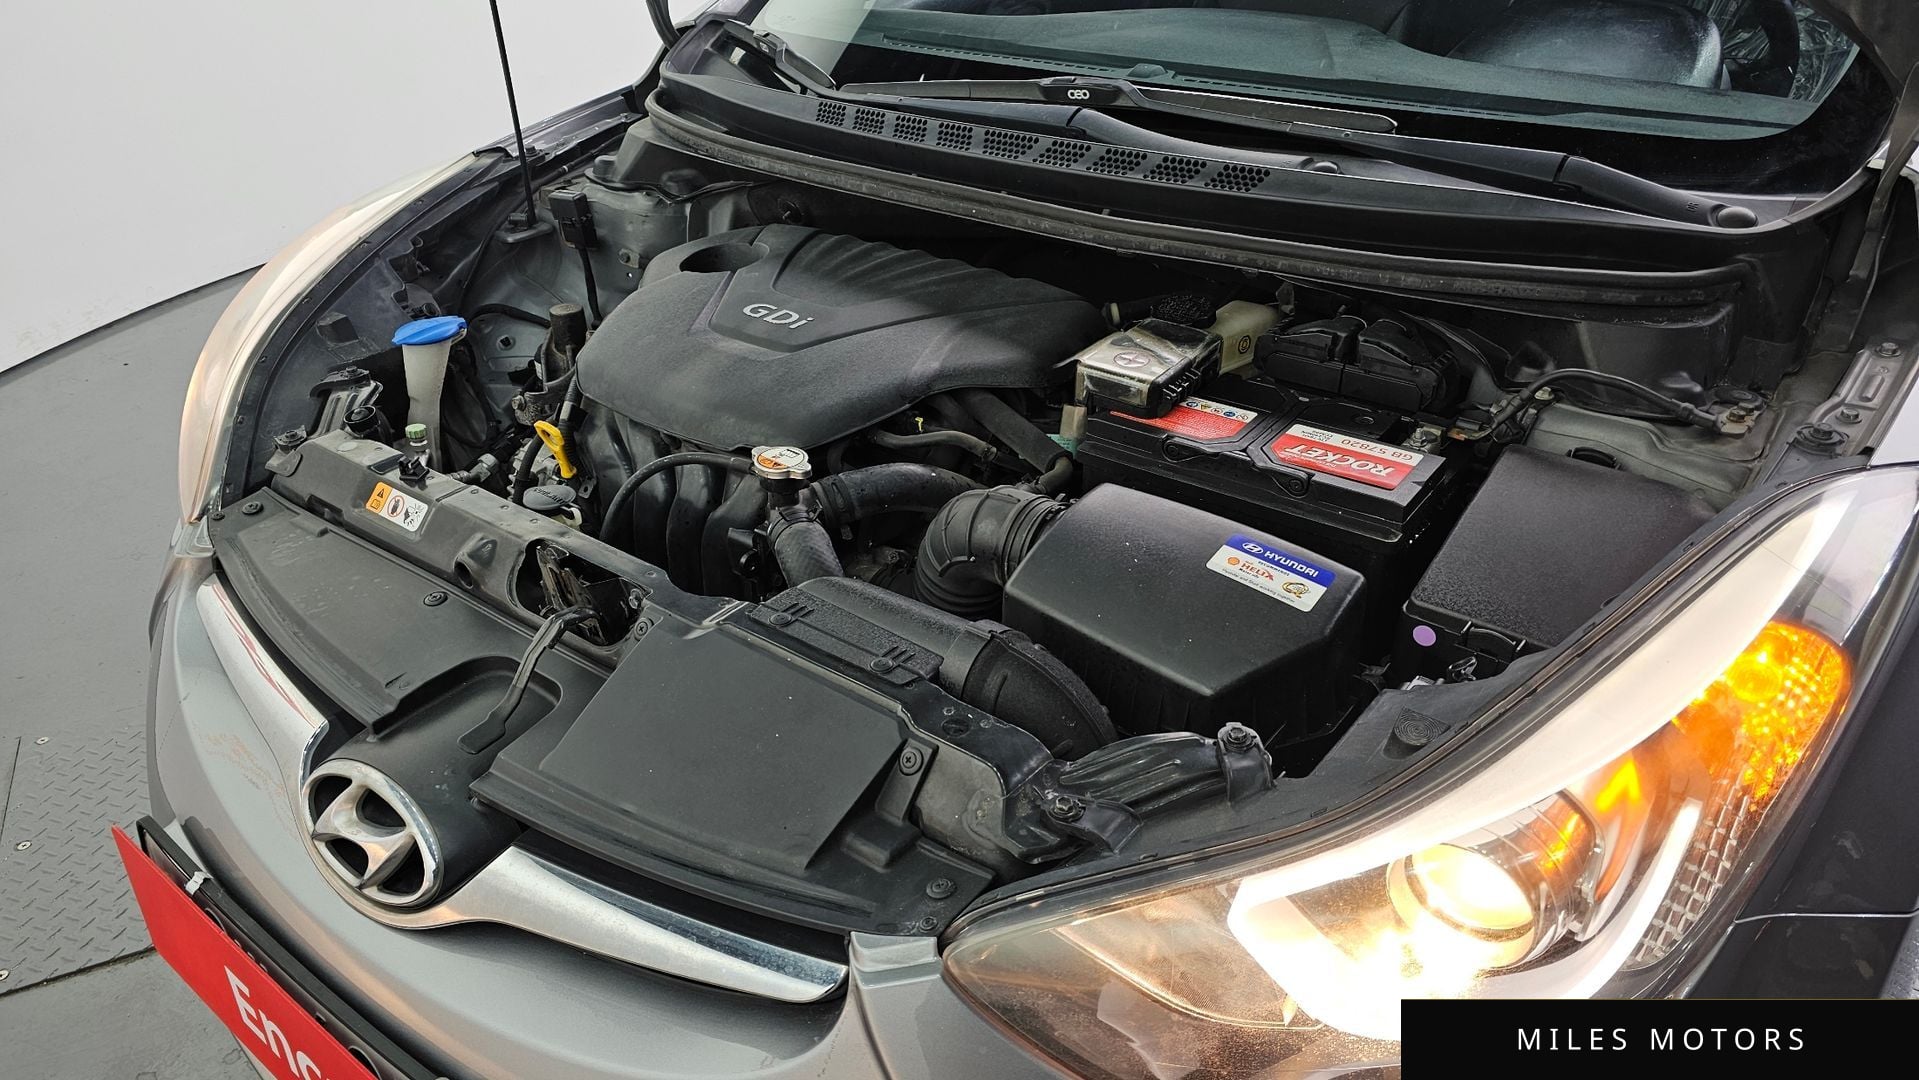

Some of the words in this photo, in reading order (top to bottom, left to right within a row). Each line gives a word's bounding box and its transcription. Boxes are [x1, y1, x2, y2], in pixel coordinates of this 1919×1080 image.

[742, 303, 815, 329] GDi
[1341, 438, 1387, 455] 57820
[1391, 451, 1413, 461] GB
[1284, 443, 1395, 477] ROCKET
[1241, 562, 1274, 581] HELIX
[1264, 550, 1319, 578] HYUNDAI
[224, 965, 329, 1080] Enc
